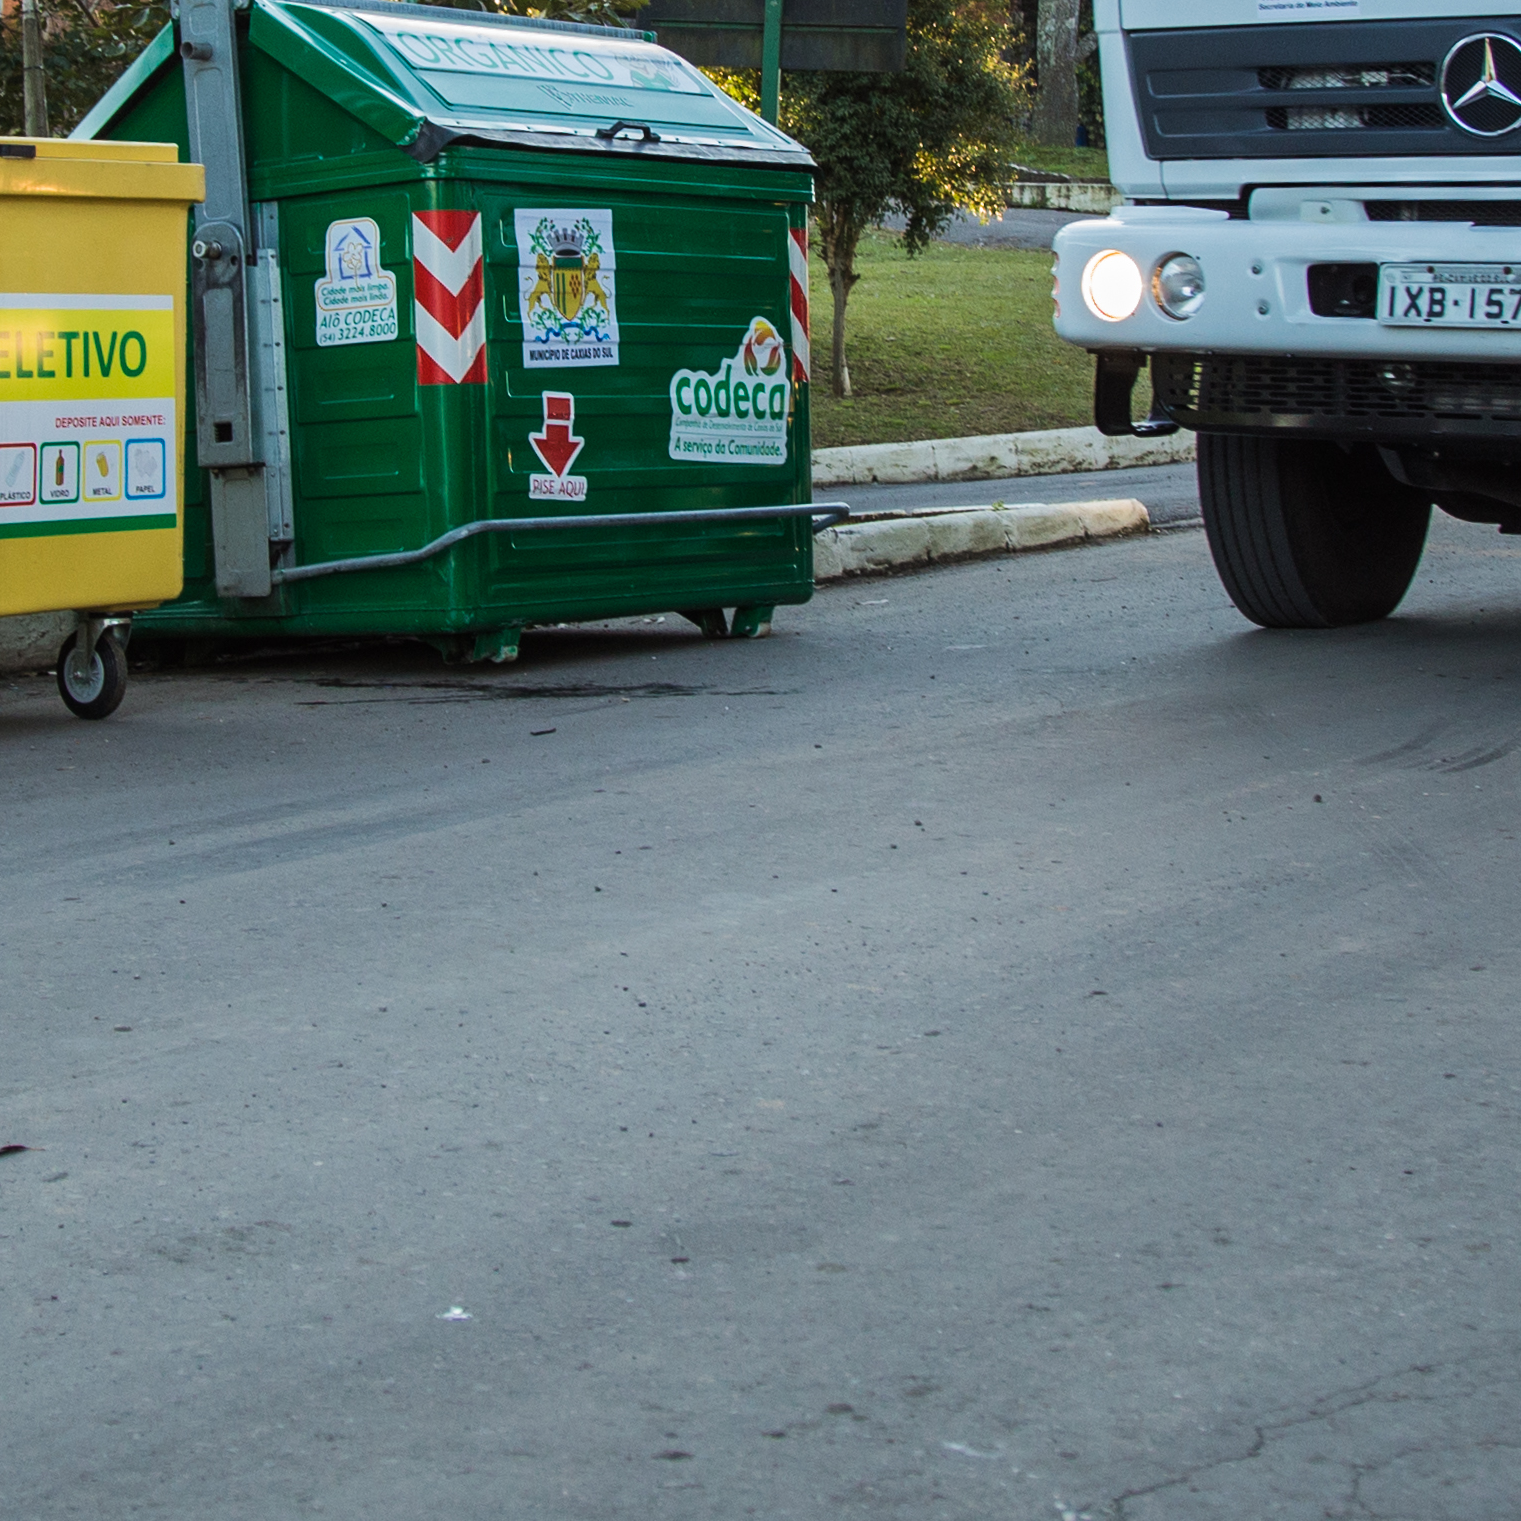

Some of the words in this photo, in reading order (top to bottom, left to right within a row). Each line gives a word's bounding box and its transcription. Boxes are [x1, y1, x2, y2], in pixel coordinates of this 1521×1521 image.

[321, 286, 347, 297] Cidade
[323, 295, 349, 306] Cidade
[350, 294, 368, 303] mais
[319, 312, 341, 330] Alô
[344, 307, 396, 326] CODECA
[319, 333, 336, 345] (54)
[338, 322, 396, 341] 3224.8000
[561, 349, 570, 360] DE
[570, 348, 592, 359] CAXIAS
[592, 347, 602, 359] DO
[602, 347, 614, 358] SUL
[675, 364, 786, 421] codeca
[55, 416, 97, 428] DEPOSITE
[98, 415, 120, 427] AQUI
[121, 414, 166, 427] SOMENTE:
[674, 436, 681, 452] A
[682, 438, 712, 458] serviço
[715, 439, 726, 454] da
[49, 489, 70, 498] VIDRO
[92, 487, 113, 496] METAL
[135, 485, 156, 493] PAPEL
[532, 479, 555, 495] PISE
[558, 480, 585, 498] AQUI
[0, 490, 31, 501] PLÁSTICO
